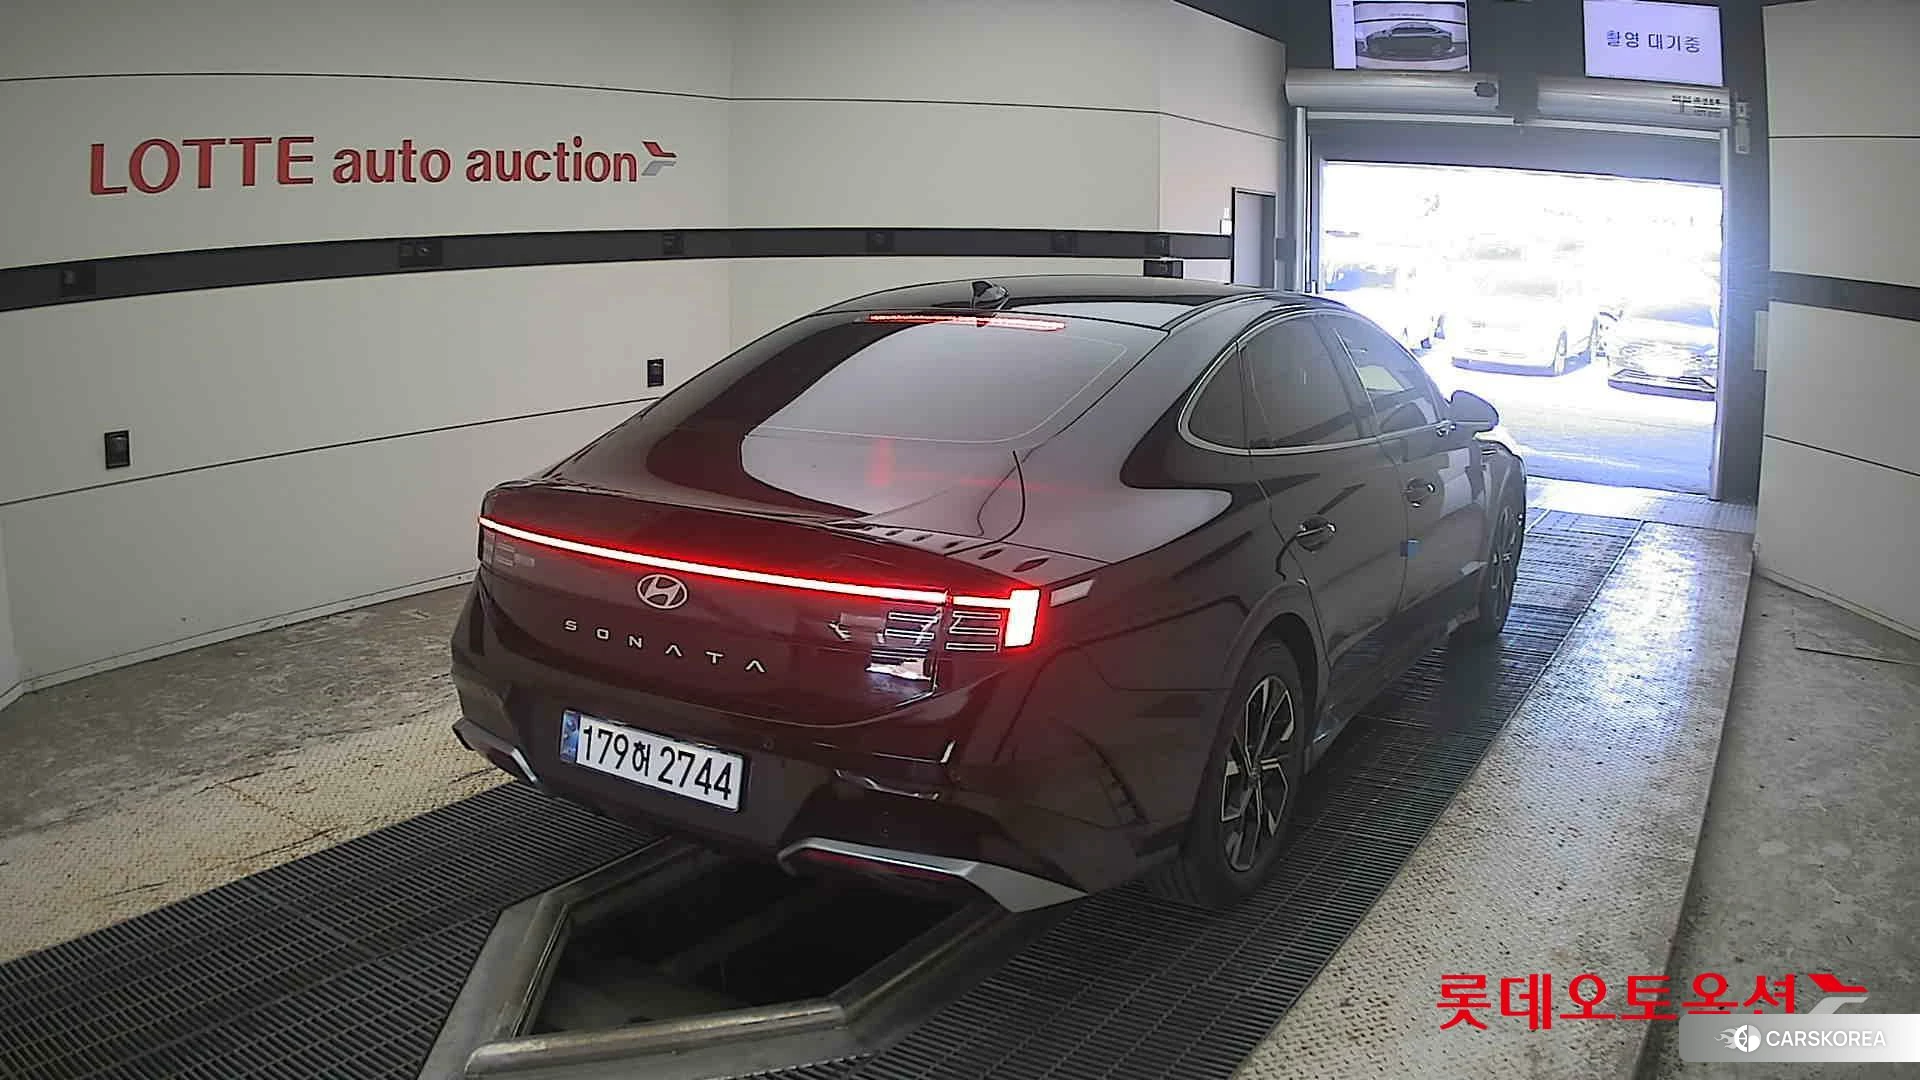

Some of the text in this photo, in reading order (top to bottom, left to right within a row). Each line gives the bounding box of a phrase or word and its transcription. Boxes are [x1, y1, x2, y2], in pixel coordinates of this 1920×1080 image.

[1647, 31, 1701, 54] 대기중
[90, 136, 638, 195] LOTTE auto auction
[564, 619, 766, 673] SONATA
[658, 746, 732, 801] 2744
